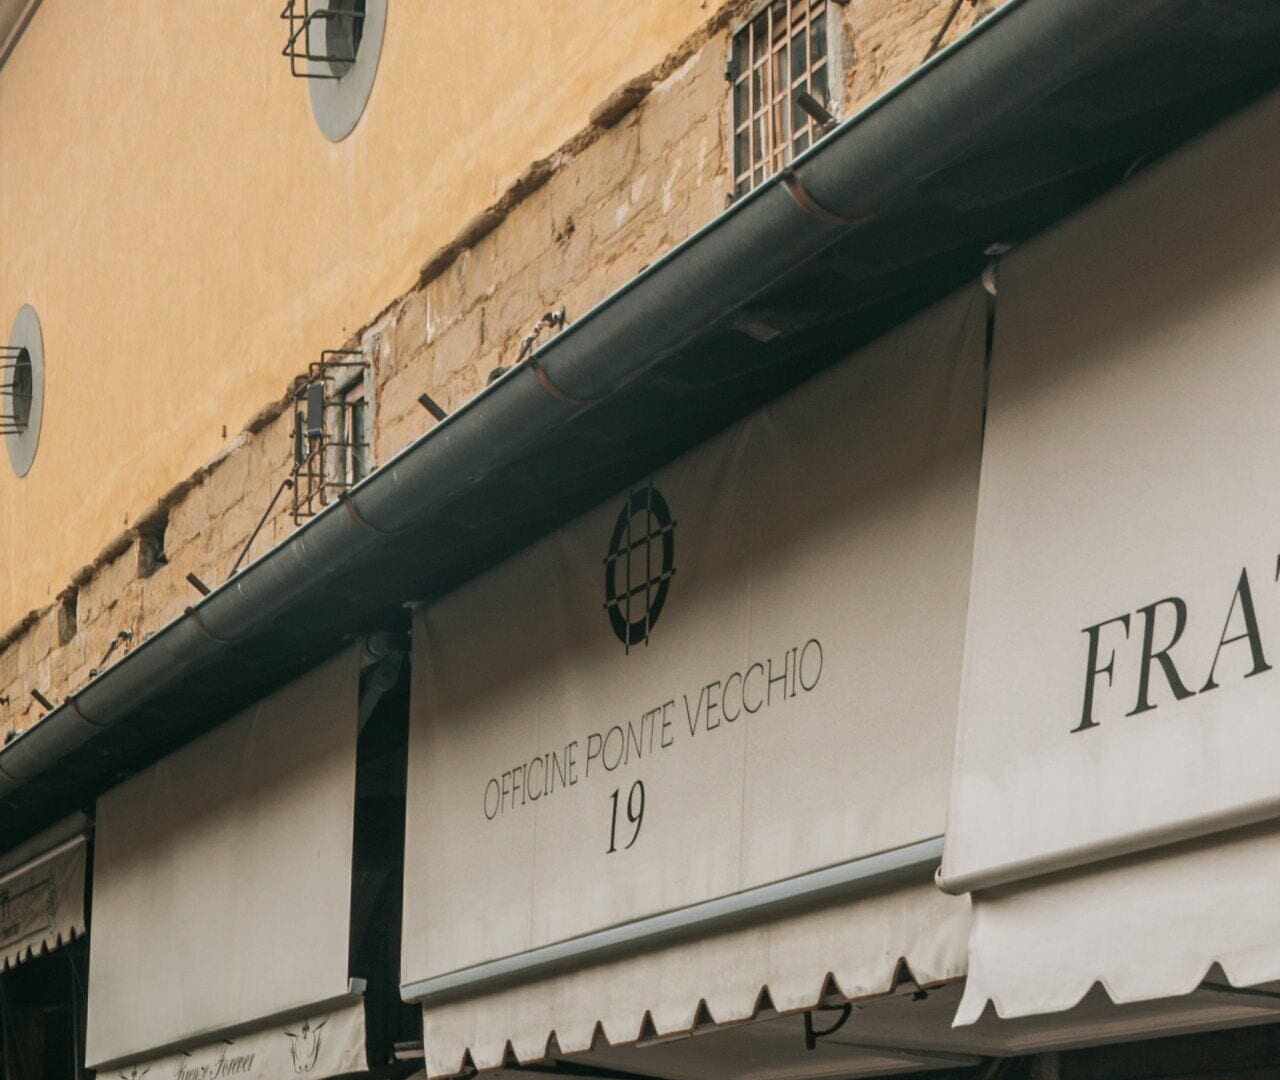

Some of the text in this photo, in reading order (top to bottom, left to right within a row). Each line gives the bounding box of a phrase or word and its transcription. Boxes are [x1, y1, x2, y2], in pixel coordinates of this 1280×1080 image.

[483, 638, 824, 821] OFFICINE PONTE VECCHIO
[1070, 553, 1280, 734] FRA
[606, 779, 646, 855] 19
